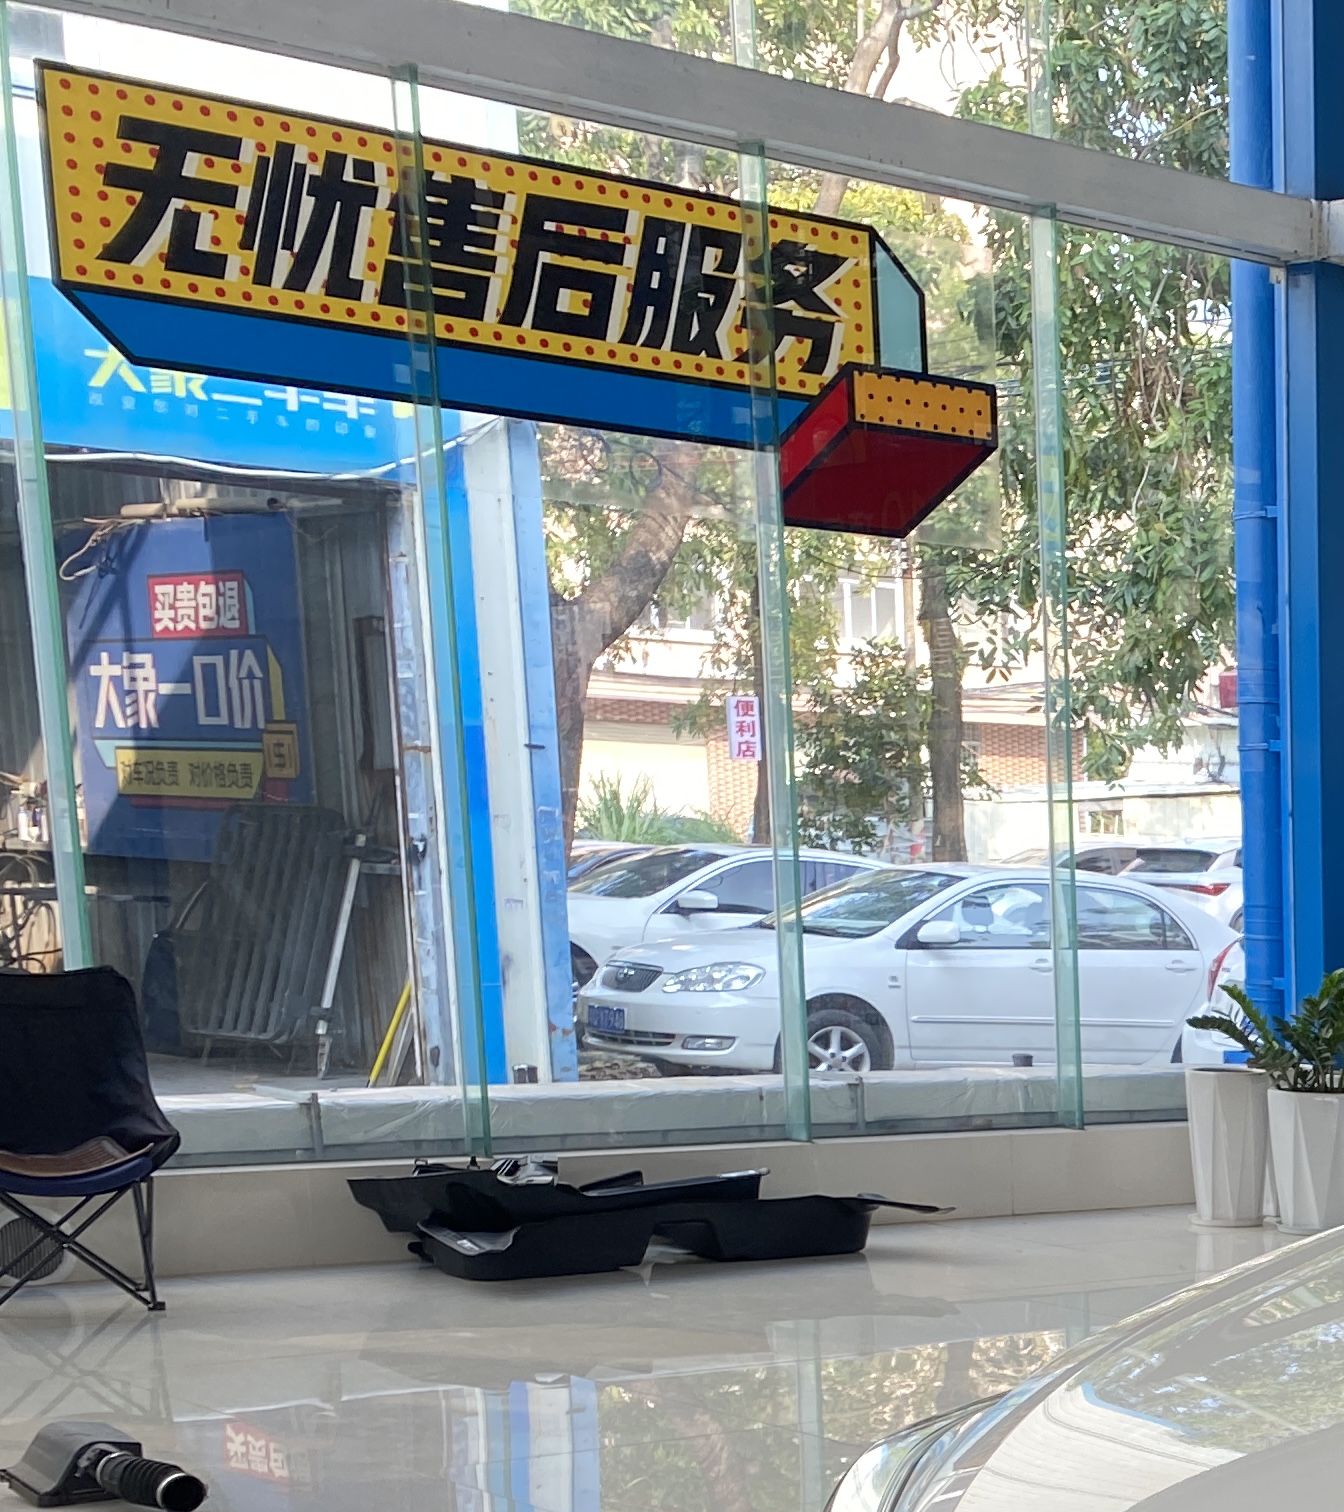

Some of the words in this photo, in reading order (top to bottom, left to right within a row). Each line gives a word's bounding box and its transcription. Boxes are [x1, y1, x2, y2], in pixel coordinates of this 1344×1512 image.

[98, 116, 854, 380] 无忧售后服务
[154, 580, 240, 633] 买贵包退
[89, 649, 266, 730] 大象一口价
[733, 699, 757, 759] 便利店
